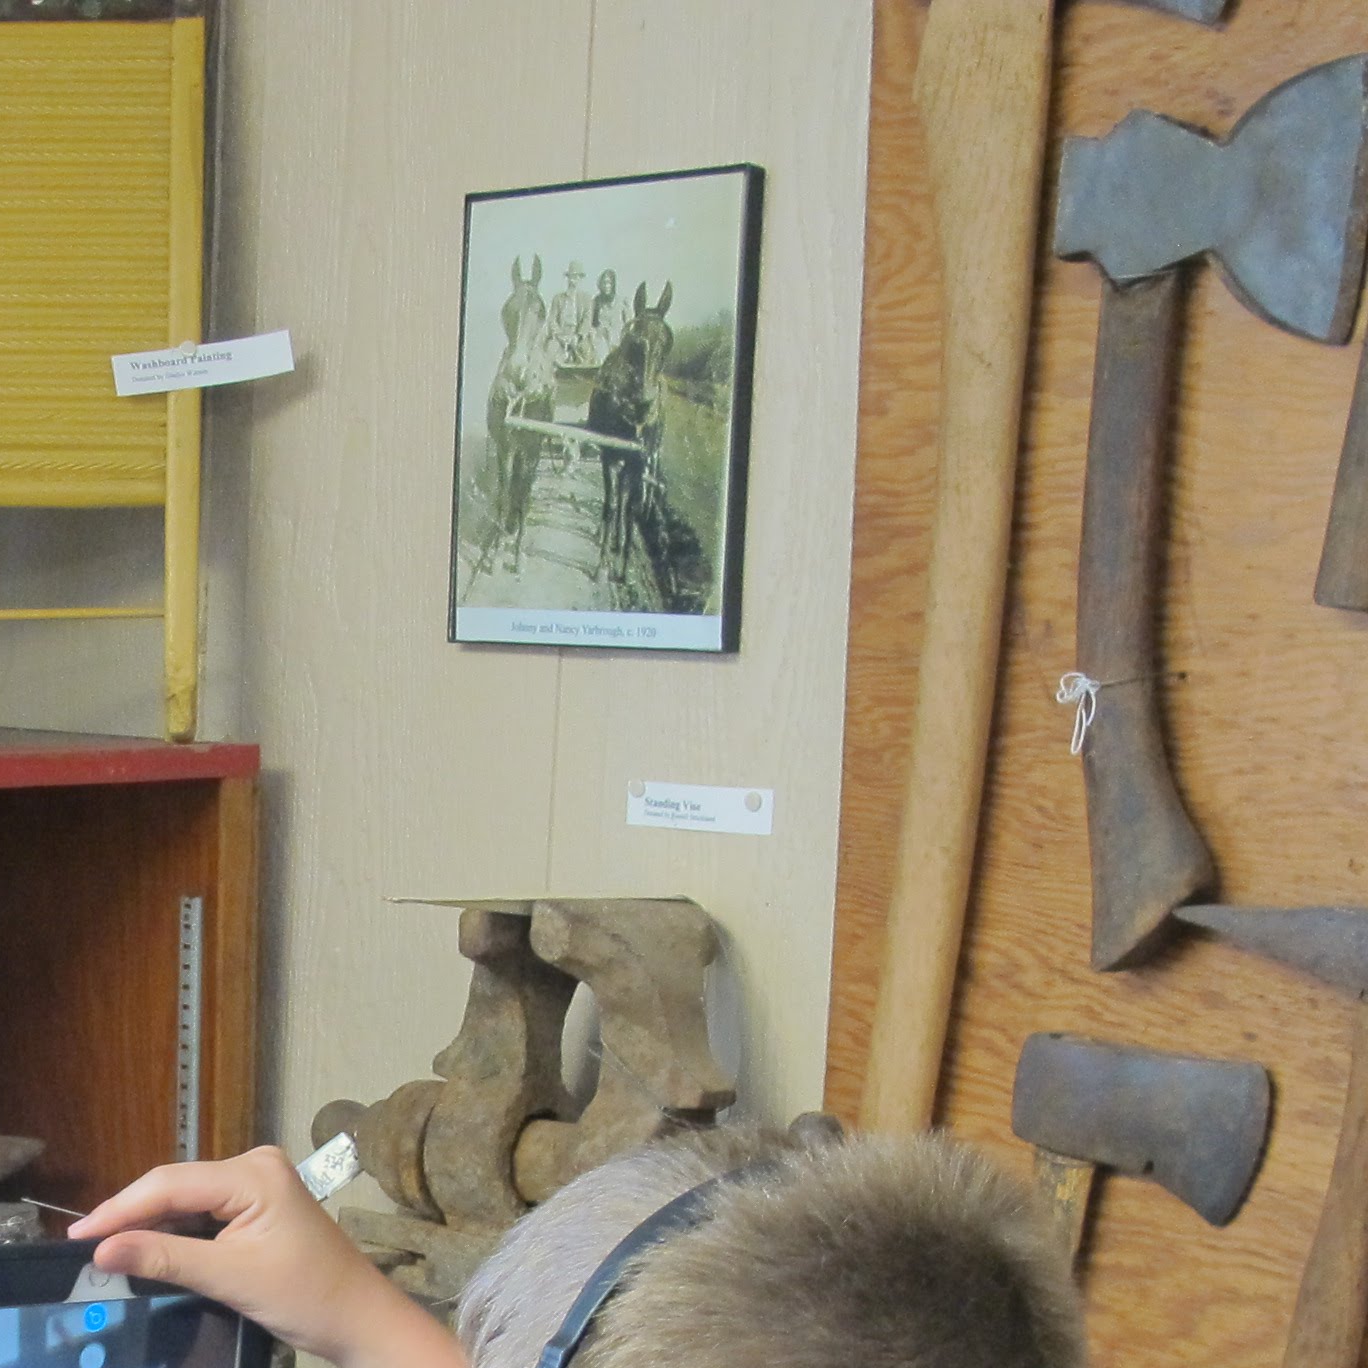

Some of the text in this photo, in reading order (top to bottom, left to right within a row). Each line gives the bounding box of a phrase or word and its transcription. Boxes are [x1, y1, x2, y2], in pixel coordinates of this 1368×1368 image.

[130, 356, 188, 371] Washboard
[539, 623, 553, 633] and
[555, 623, 580, 637] Nancy
